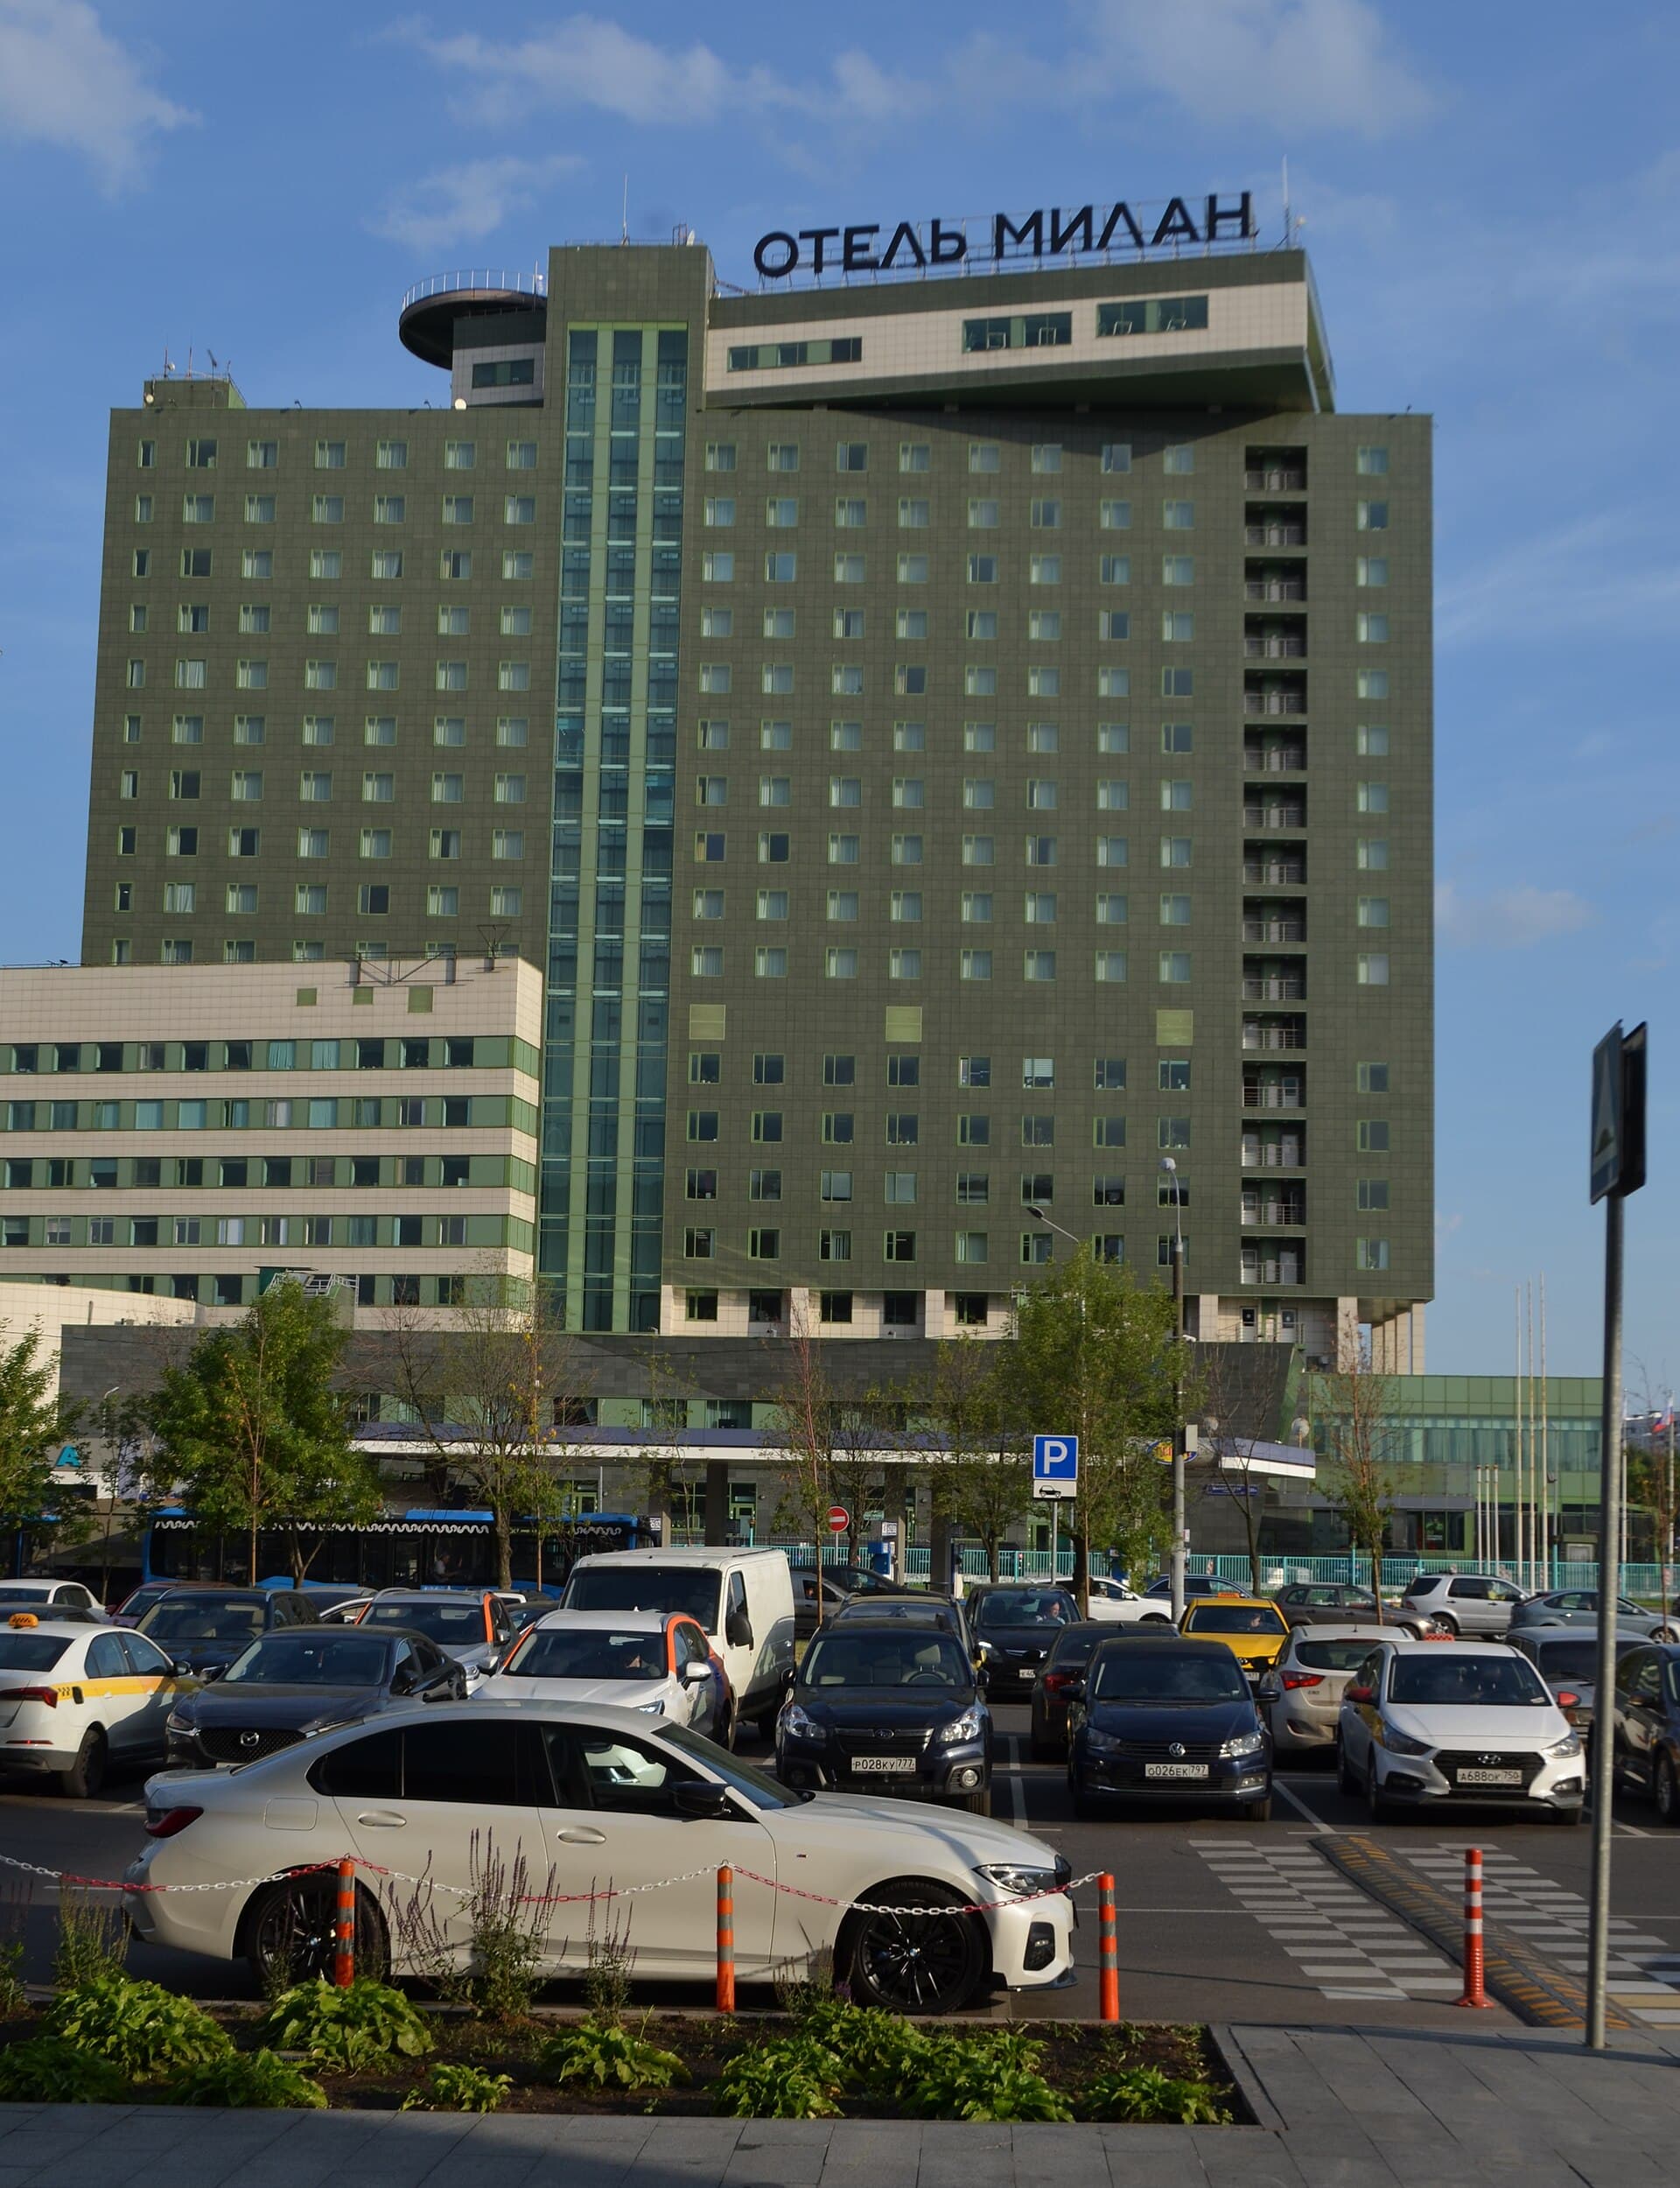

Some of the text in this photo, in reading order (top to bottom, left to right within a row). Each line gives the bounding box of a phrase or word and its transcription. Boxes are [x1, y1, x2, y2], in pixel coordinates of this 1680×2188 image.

[753, 191, 1251, 277] ОТЕЛЬ МИЛАН
[1044, 1441, 1068, 1475] P
